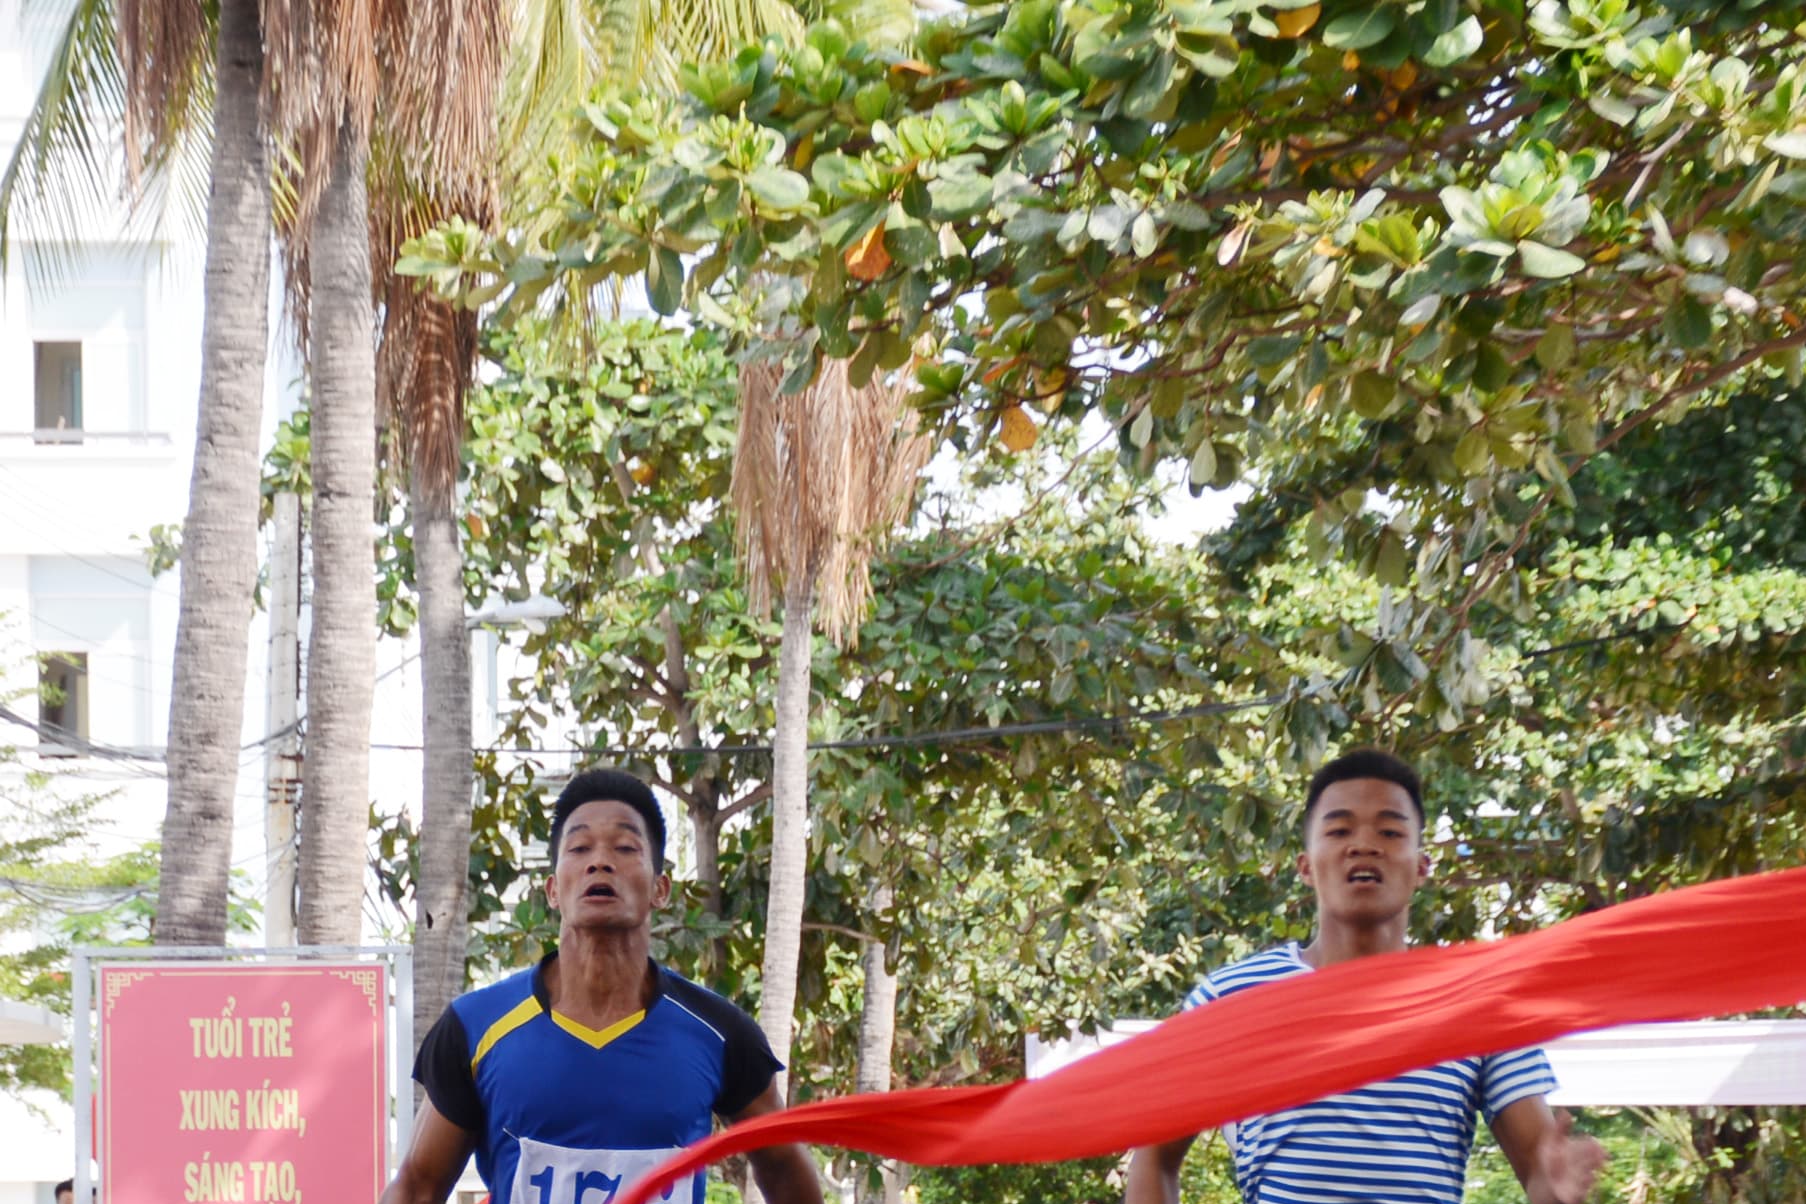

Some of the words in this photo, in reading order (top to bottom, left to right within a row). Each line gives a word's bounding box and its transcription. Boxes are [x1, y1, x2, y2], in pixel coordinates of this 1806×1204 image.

[190, 996, 243, 1058] TUỔI
[249, 1002, 293, 1058] TRẺ
[179, 1089, 239, 1130] XUNG
[246, 1079, 306, 1137] KÍCH,
[184, 1152, 243, 1203] SÁNG
